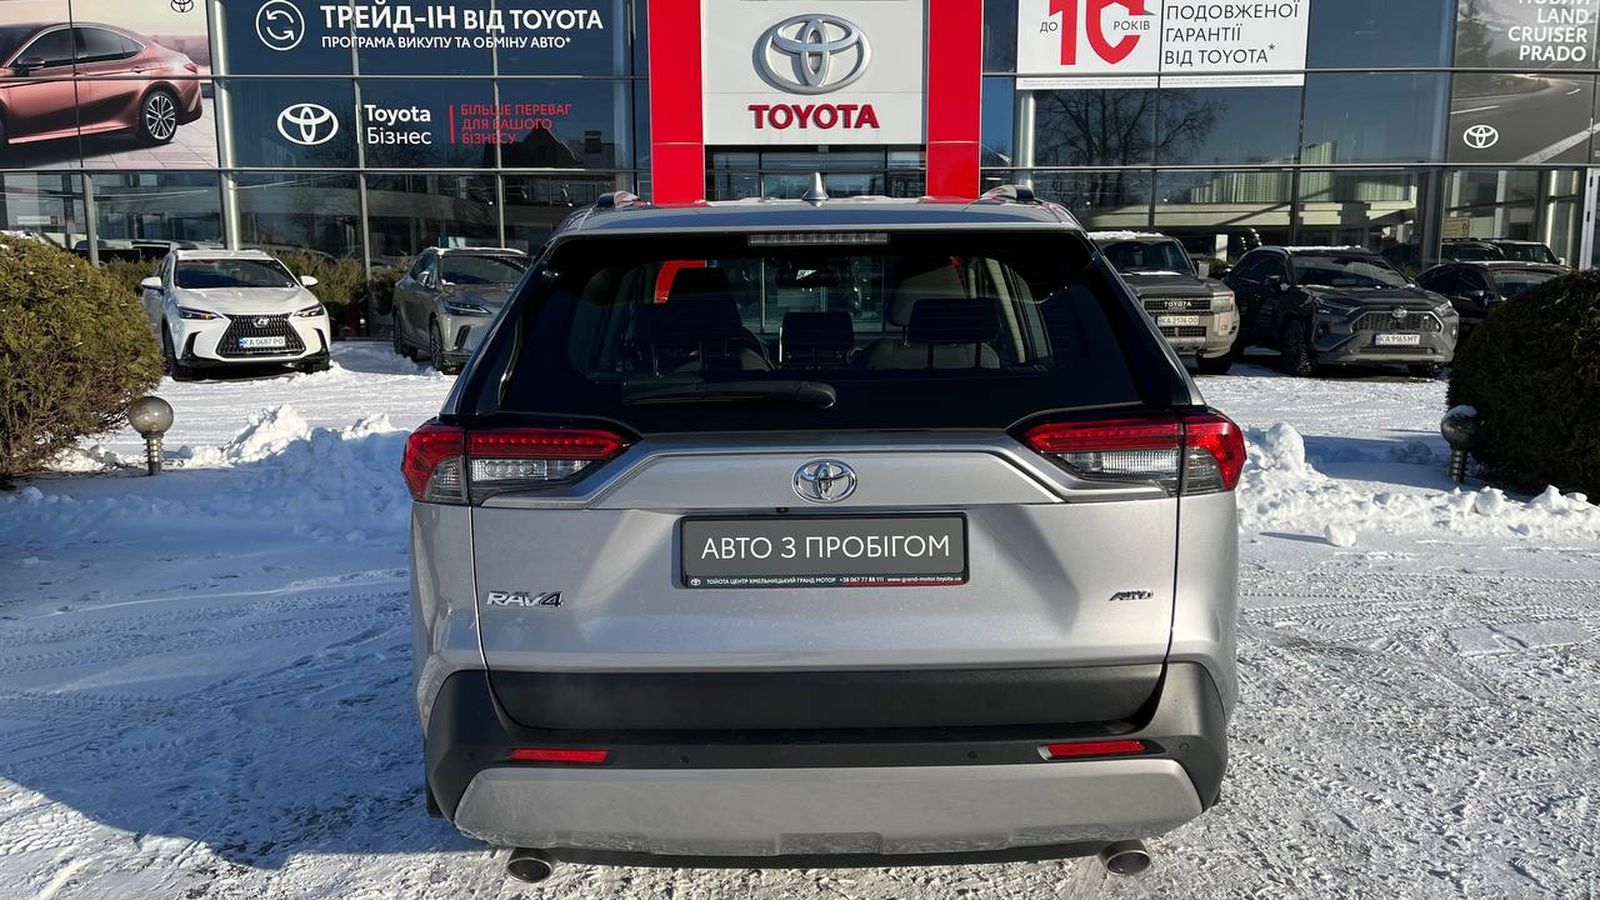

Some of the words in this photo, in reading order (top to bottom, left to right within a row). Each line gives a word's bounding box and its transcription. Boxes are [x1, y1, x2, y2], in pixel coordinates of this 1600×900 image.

[320, 0, 456, 34] ТРЕЙД-ІН
[463, 9, 505, 33] ВІД
[509, 9, 604, 29] TOYOTA
[1167, 0, 1299, 22] ПОДОВЖЕНОЇ
[1537, 7, 1589, 24] LAND
[1040, 21, 1058, 33] ДО
[1113, 20, 1150, 31] РОКІВ
[1165, 23, 1243, 42] ГАРАНТІЇ
[1508, 26, 1587, 43] CRUISER
[321, 36, 395, 48] ПРОГРАМА
[398, 36, 452, 48] ВИКУПУ
[455, 37, 471, 48] ТА
[473, 37, 528, 48] ОБМІНУ
[1164, 50, 1193, 67] ВІД
[1519, 44, 1586, 62] PRADO
[364, 104, 431, 126] Toyota
[461, 103, 511, 116] БІЛЬШЕ
[515, 103, 572, 116] ПЕРЕВАГ
[748, 103, 880, 129] TOYOTA
[462, 118, 488, 131] ДЛЯ
[367, 127, 432, 145] Бізнес
[701, 536, 772, 559] АВТО
[781, 536, 796, 559] З
[806, 534, 950, 558] ПРОБІГОМ
[486, 590, 564, 608] RAV4
